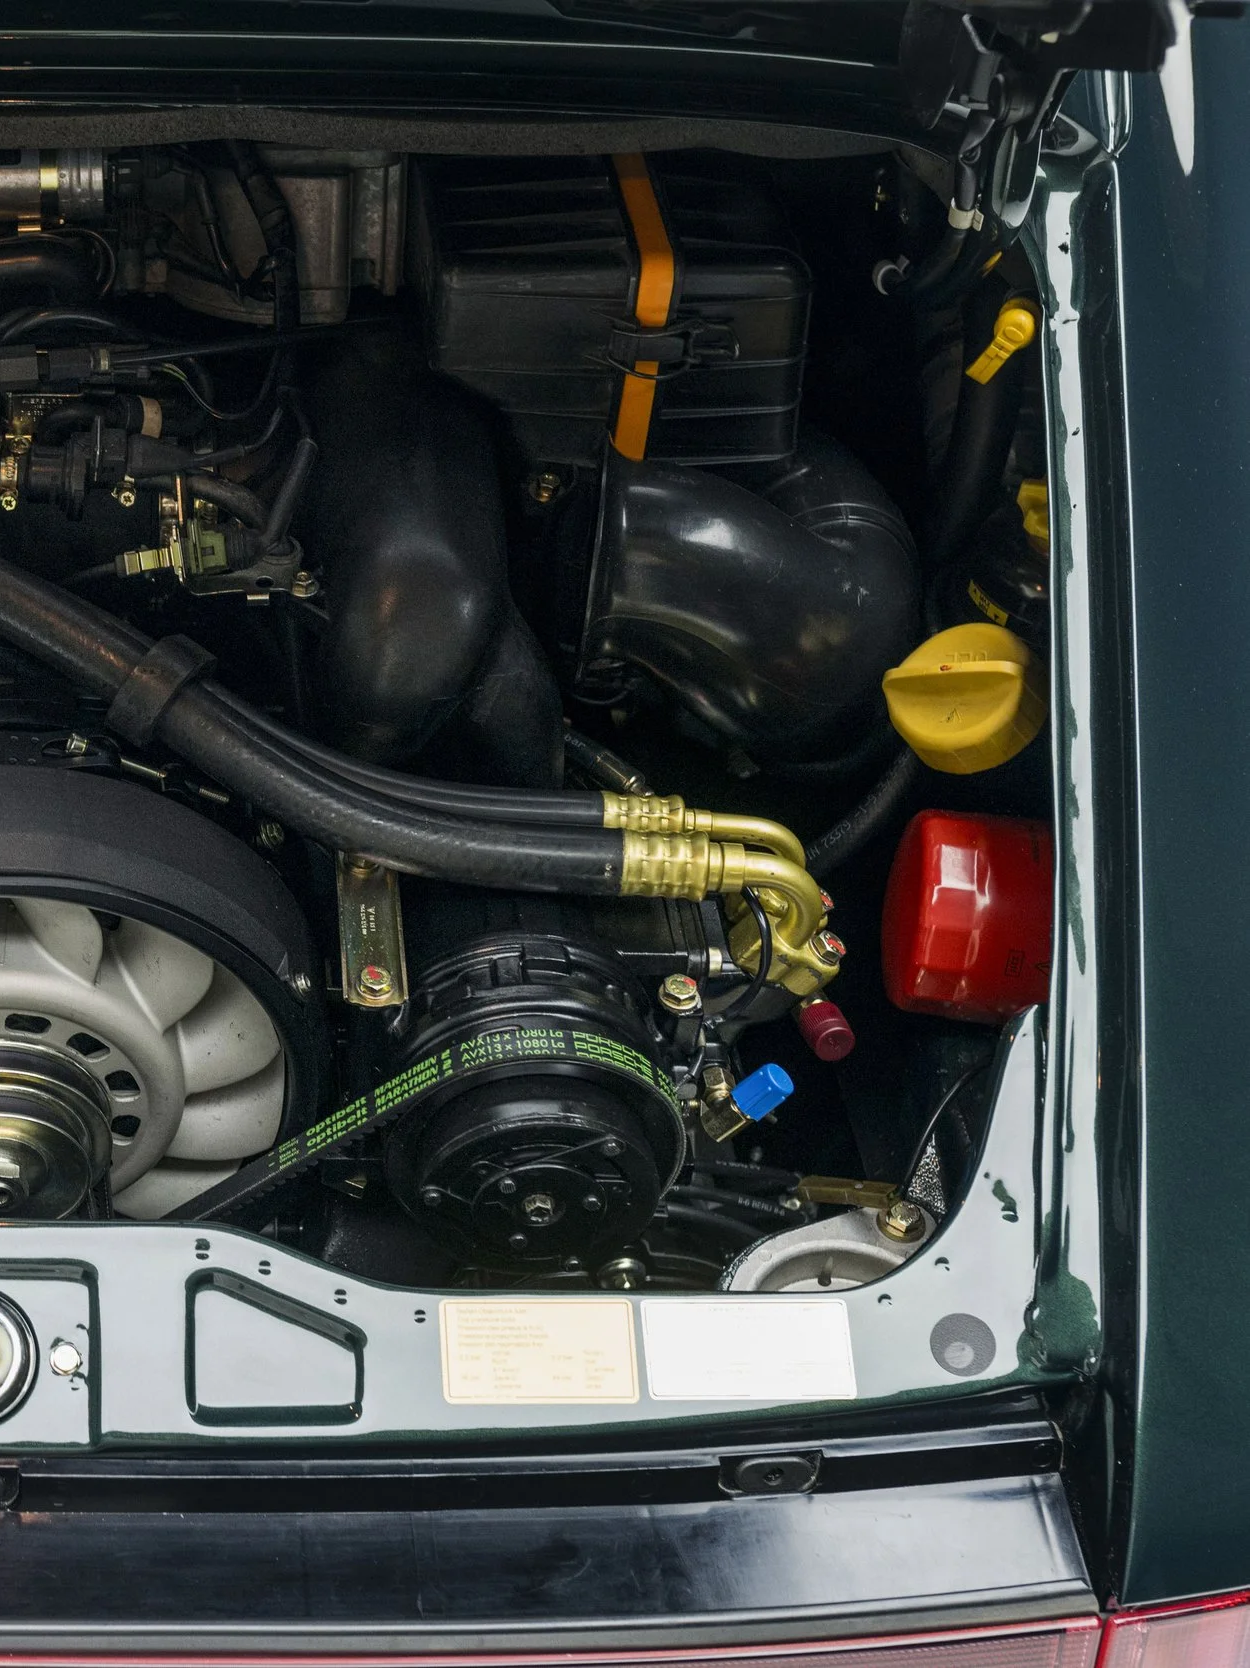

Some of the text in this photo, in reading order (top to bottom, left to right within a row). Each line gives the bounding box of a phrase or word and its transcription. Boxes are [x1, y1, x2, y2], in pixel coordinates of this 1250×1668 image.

[564, 733, 586, 748] bar
[459, 1033, 501, 1052] AVX13
[306, 1107, 368, 1147] optibelt
[375, 1065, 439, 1107] MARATHON
[442, 1059, 452, 1070] 2
[461, 1043, 503, 1062] AVX13
[517, 1039, 548, 1049] 1080
[551, 1039, 565, 1048] La
[574, 1041, 653, 1078] PORSCHE
